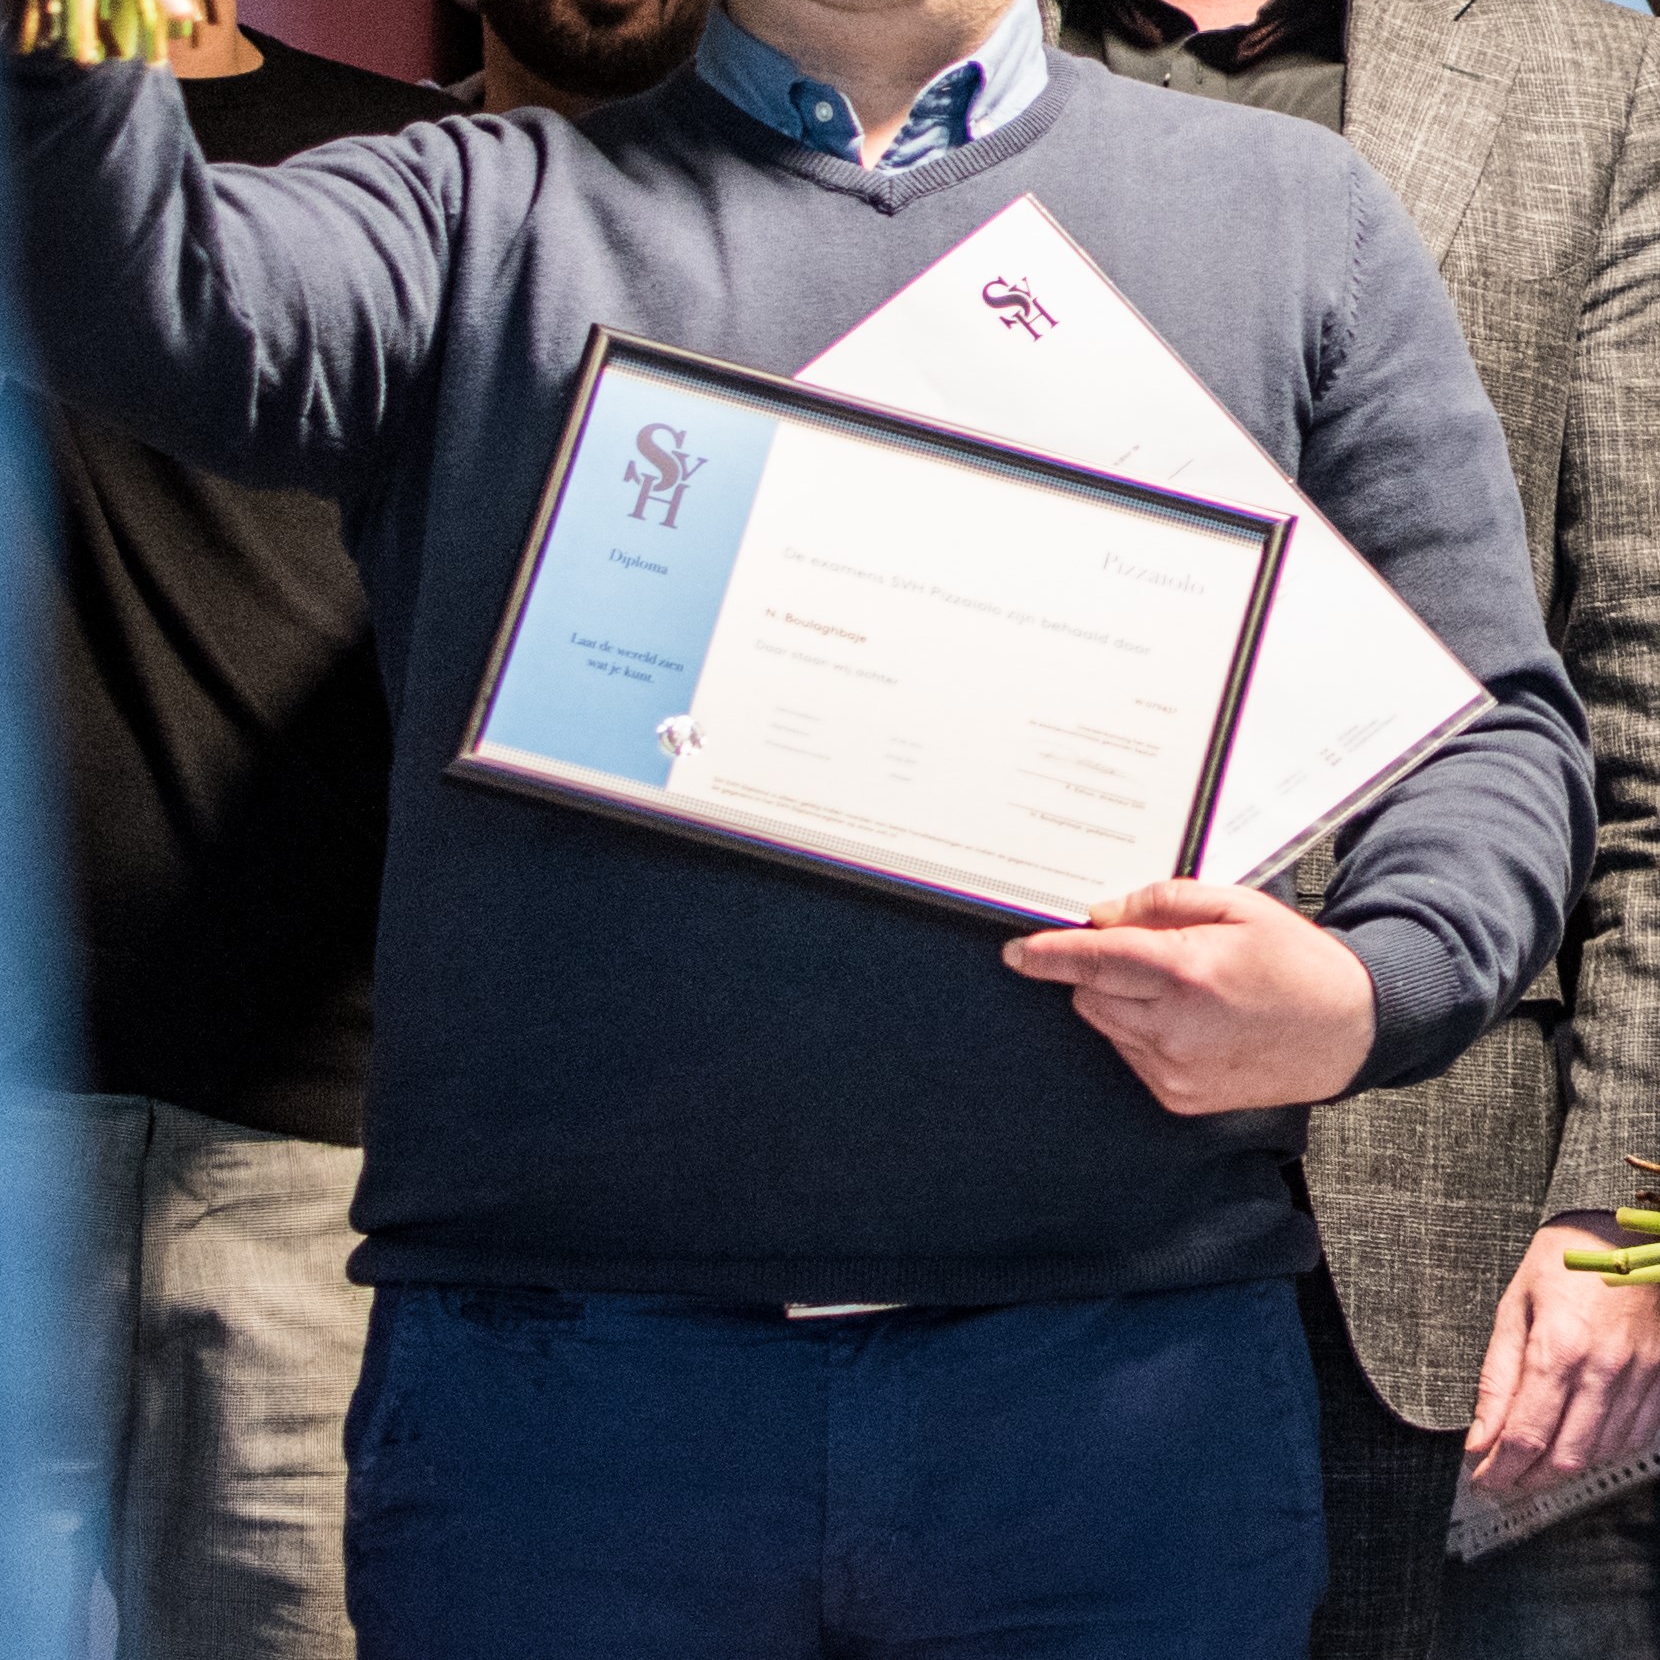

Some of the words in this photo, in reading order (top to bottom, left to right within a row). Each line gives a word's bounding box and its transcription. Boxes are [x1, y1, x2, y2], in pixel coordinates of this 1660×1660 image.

[609, 548, 668, 575] Diploma
[1104, 551, 1205, 595] Pizzaiolo
[784, 546, 806, 562] De
[811, 556, 885, 585] examens
[892, 575, 925, 593] SVH
[930, 586, 1002, 615] Pizzaiolo
[1007, 608, 1036, 625] zijn
[1041, 615, 1109, 645] behaald
[1113, 638, 1151, 655] door
[570, 632, 597, 649] Laat
[600, 641, 613, 653] de
[617, 647, 658, 666] wereld
[658, 659, 684, 673] zien
[587, 658, 608, 671] wat
[609, 662, 622, 676] je
[755, 639, 787, 655] Daar
[792, 650, 829, 667] staan
[833, 662, 852, 676] wij
[855, 668, 898, 685] achter
